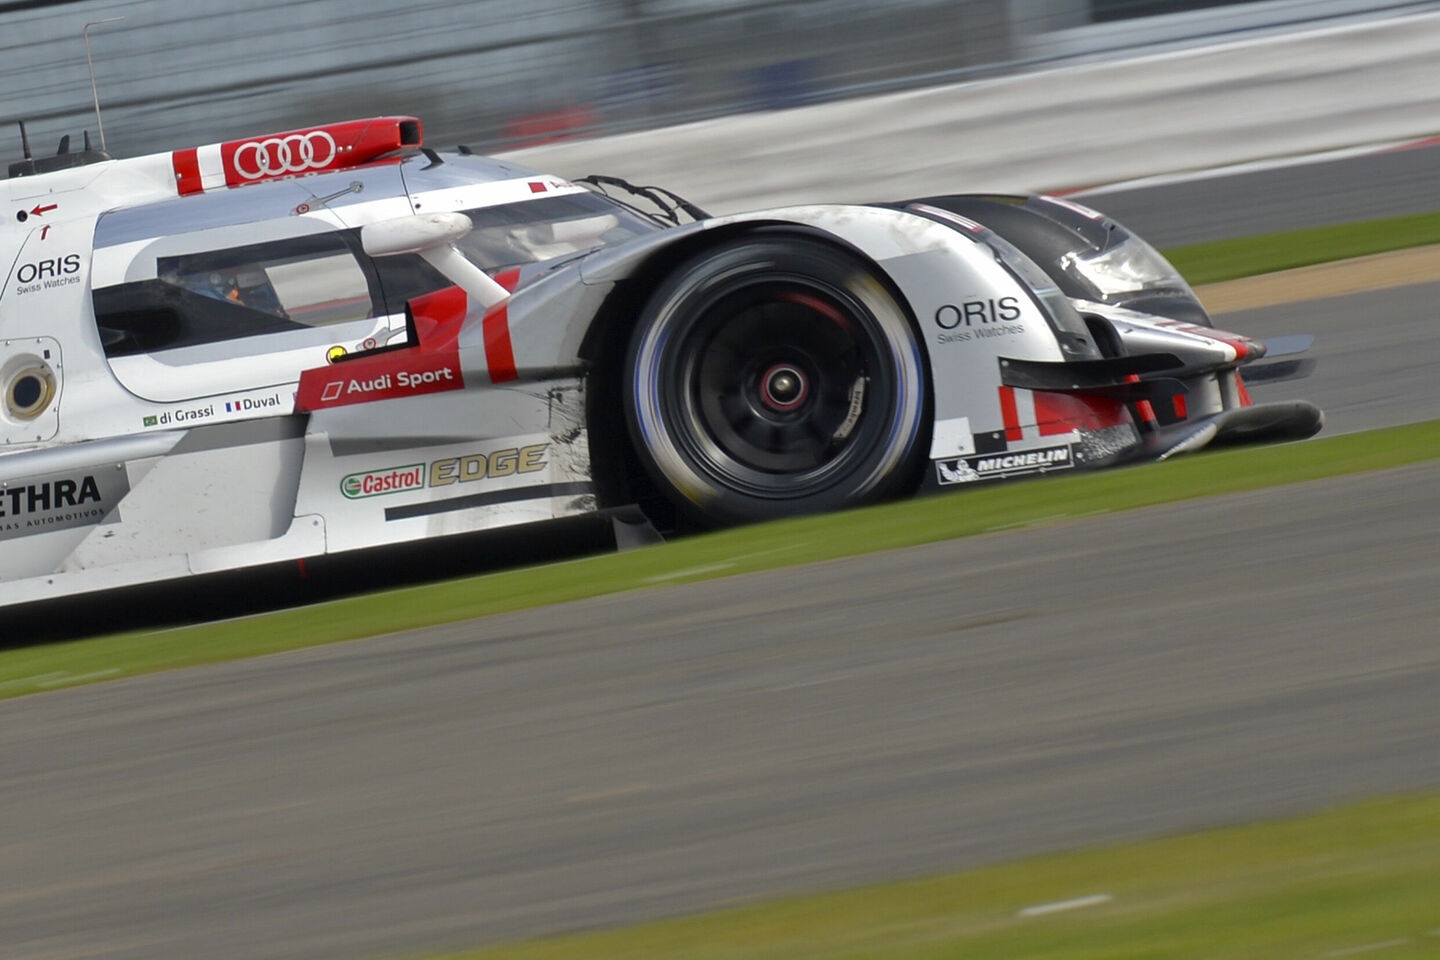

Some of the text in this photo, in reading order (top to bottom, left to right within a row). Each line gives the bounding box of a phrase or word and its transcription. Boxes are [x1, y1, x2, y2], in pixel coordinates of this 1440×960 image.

[17, 254, 81, 283] ORIS
[16, 275, 81, 295] Swiss Watches
[935, 296, 1021, 330] ORIS
[938, 323, 1025, 345] Swiss Watches
[347, 367, 453, 394] Audi Sport
[243, 394, 281, 411] Duval
[160, 404, 214, 425] di Grassi
[363, 442, 552, 494] Castrol EDGE
[977, 449, 1068, 472] MICHELIN
[27, 507, 105, 527] AUTOMOTIVOS
